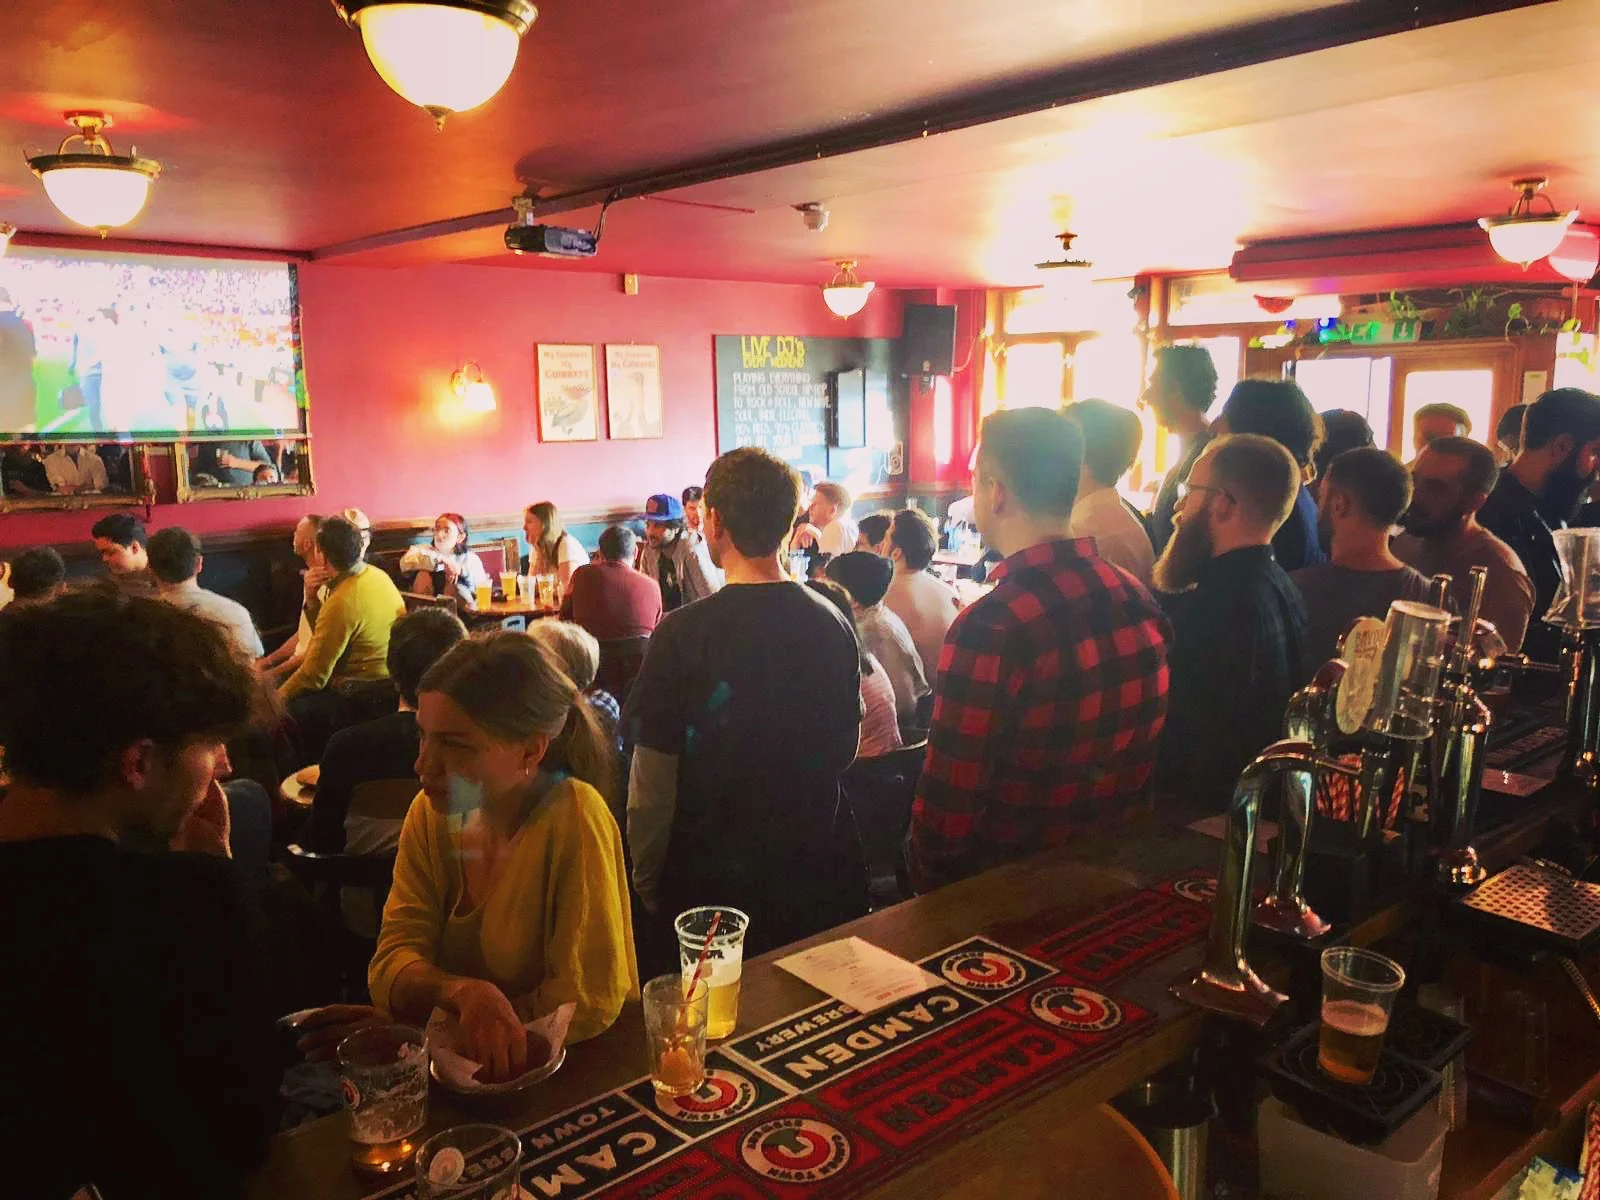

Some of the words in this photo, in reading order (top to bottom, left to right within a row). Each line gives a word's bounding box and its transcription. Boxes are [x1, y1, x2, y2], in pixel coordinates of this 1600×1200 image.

[741, 336, 770, 357] LIVE
[734, 384, 756, 396] FROM
[734, 397, 743, 409] TO
[746, 396, 768, 409] ROCK
[785, 995, 960, 1080] CAMDEN
[530, 1106, 616, 1149] TOWN
